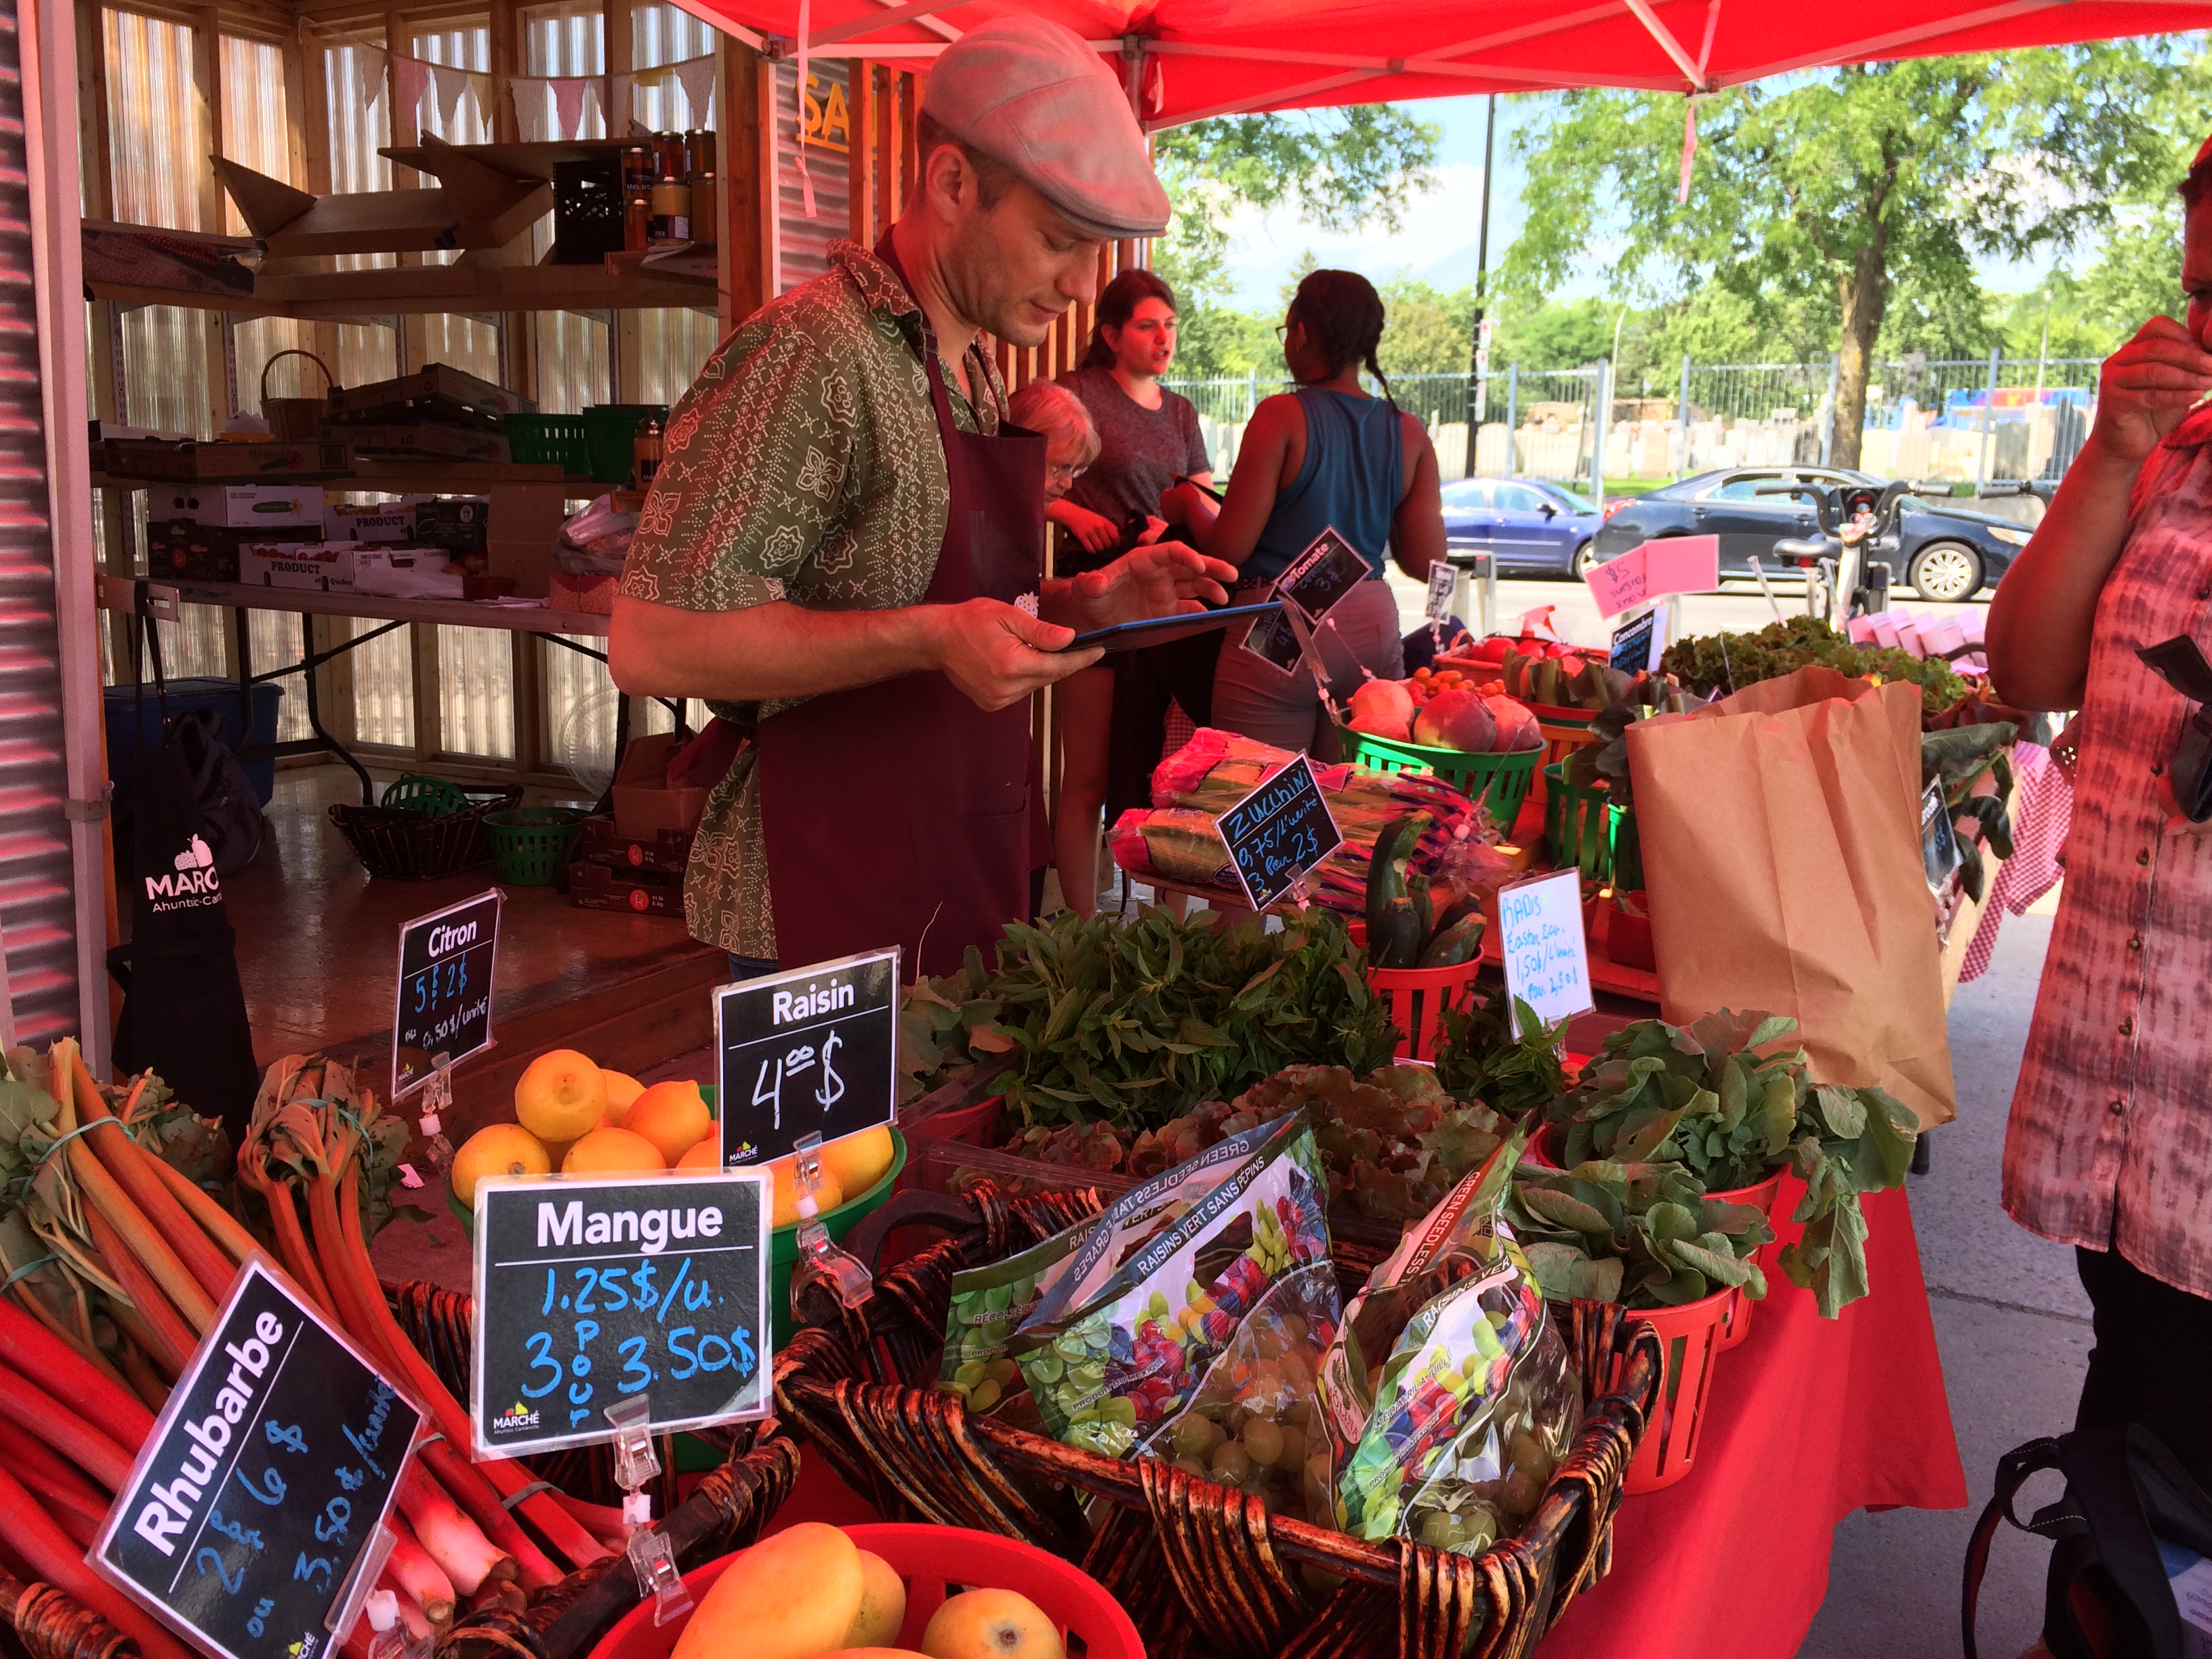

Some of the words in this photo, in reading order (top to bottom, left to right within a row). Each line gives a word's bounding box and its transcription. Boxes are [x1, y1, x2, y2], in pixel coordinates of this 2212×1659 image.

[356, 515, 405, 528] PRODUCT
[271, 561, 321, 574] PRODUCT
[1290, 543, 1330, 579] Tomate
[1247, 872, 1265, 892] 3
[428, 920, 476, 958] Citron
[415, 976, 426, 1012] 5
[773, 978, 855, 1025] Raisin
[729, 1145, 758, 1162] MARCHÉ
[1448, 1171, 1481, 1210] GREEN
[537, 1201, 723, 1253] Mangue
[1136, 1231, 1183, 1275] RAISINS
[1178, 1208, 1208, 1238] VERT
[1206, 1182, 1240, 1215] SANS
[1236, 1156, 1265, 1189] PÉPINS
[1406, 1212, 1454, 1274] SEEDLESS
[974, 1305, 1023, 1325] RÉCOLTE
[1422, 1277, 1478, 1330] RAISINS
[521, 1332, 562, 1398] 3
[1073, 1385, 1113, 1410] PRODUIT
[1112, 1377, 1128, 1389] DU
[1128, 1356, 1166, 1382] MEXIQUE
[134, 1311, 283, 1557] Rhubarbe
[493, 1410, 539, 1429] MARCHÉ
[197, 1547, 245, 1595] 2
